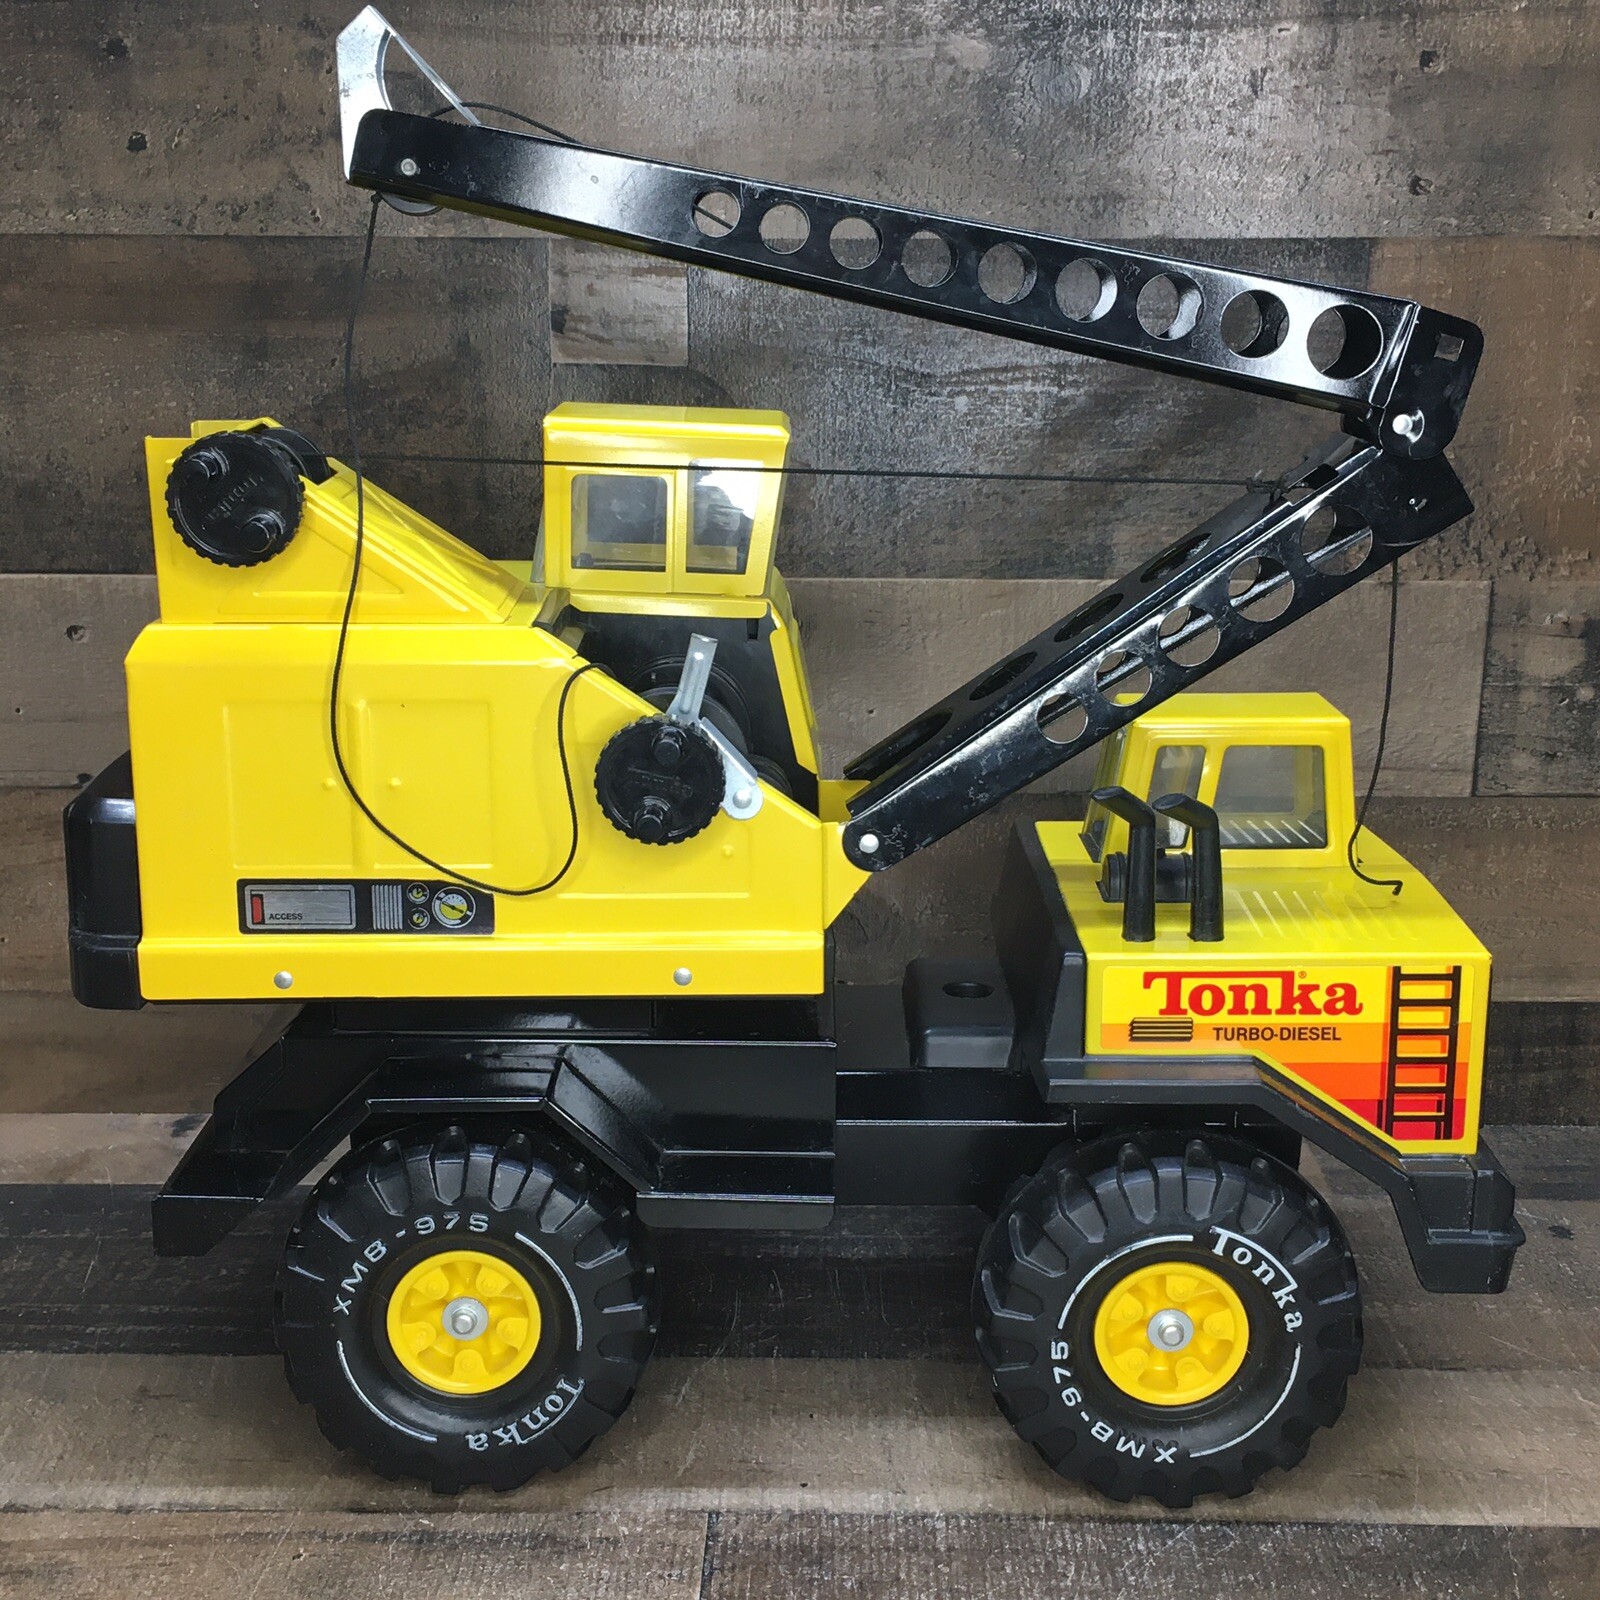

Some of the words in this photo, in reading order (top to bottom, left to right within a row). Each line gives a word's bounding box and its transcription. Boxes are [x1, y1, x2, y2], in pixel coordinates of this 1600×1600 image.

[1144, 971, 1363, 1016] Tonka
[1213, 1027, 1342, 1041] TURBO-DIESEL
[1209, 1225, 1303, 1333] Tonka
[465, 1376, 585, 1451] Tonka
